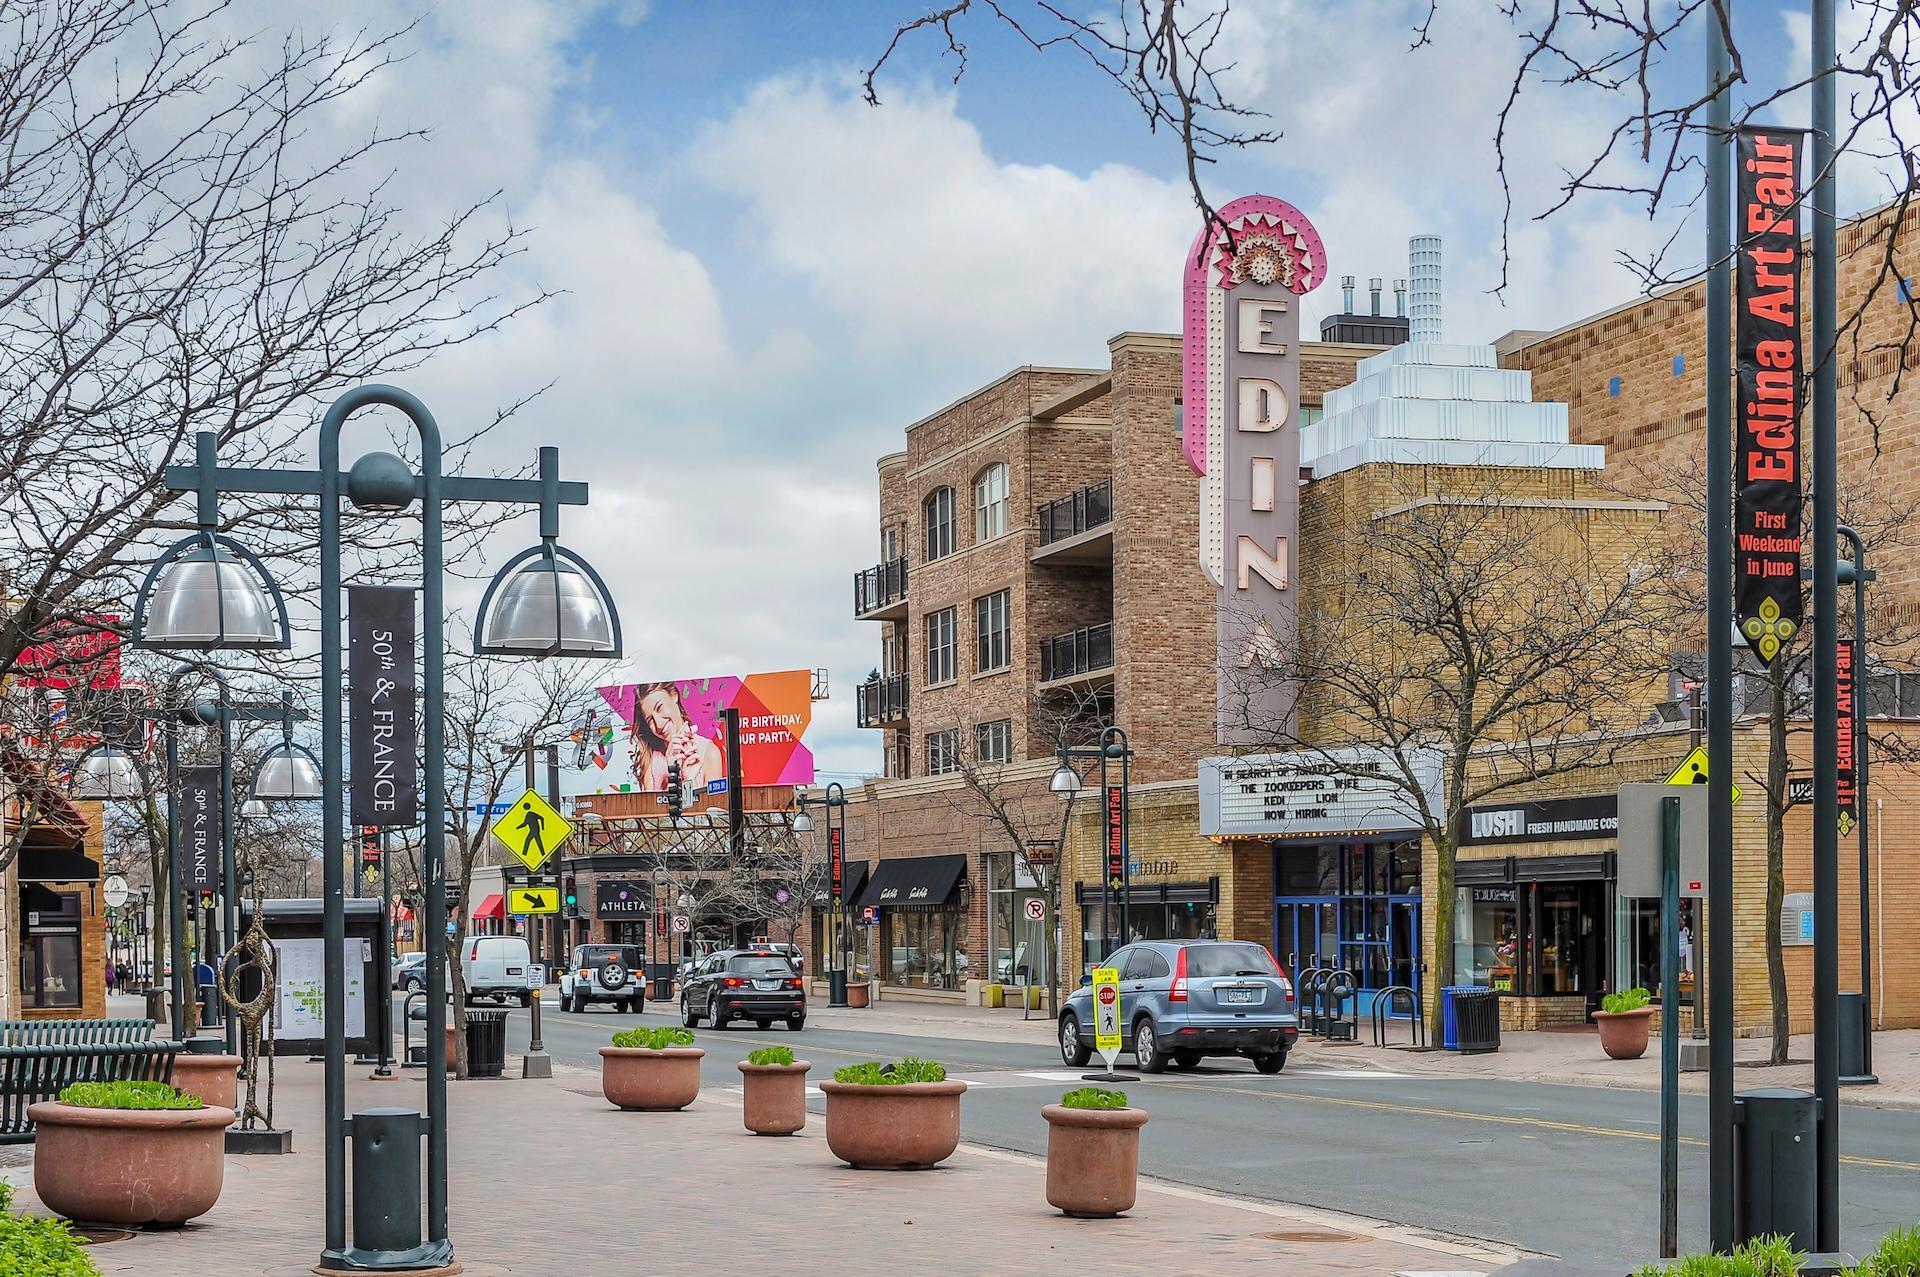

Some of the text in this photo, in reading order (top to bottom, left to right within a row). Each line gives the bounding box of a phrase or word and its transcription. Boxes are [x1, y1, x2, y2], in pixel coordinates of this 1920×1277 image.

[1746, 135, 1795, 483] Edina Art Fair
[1755, 511, 1787, 529] First
[1739, 533, 1800, 553] Weekend
[1747, 557, 1794, 578] in June
[371, 630, 395, 811] 50th & FRANCE
[751, 713, 803, 728] BIRTHDAY.
[758, 731, 793, 744] PARTY.
[1240, 783, 1257, 794] THE
[1264, 780, 1325, 793] ZOOKEEPERS
[1110, 788, 1121, 808] Fair
[1264, 793, 1338, 806] KEDI LION
[1110, 806, 1121, 824] Art
[1264, 808, 1328, 820] NOW HIRING
[1472, 810, 1524, 838] LUSH
[1527, 822, 1553, 835] FRESH
[1554, 818, 1599, 832] HANDMADE
[1110, 826, 1121, 856] Edina
[194, 830, 208, 884] FRANCE
[601, 901, 646, 911] ATHLETA
